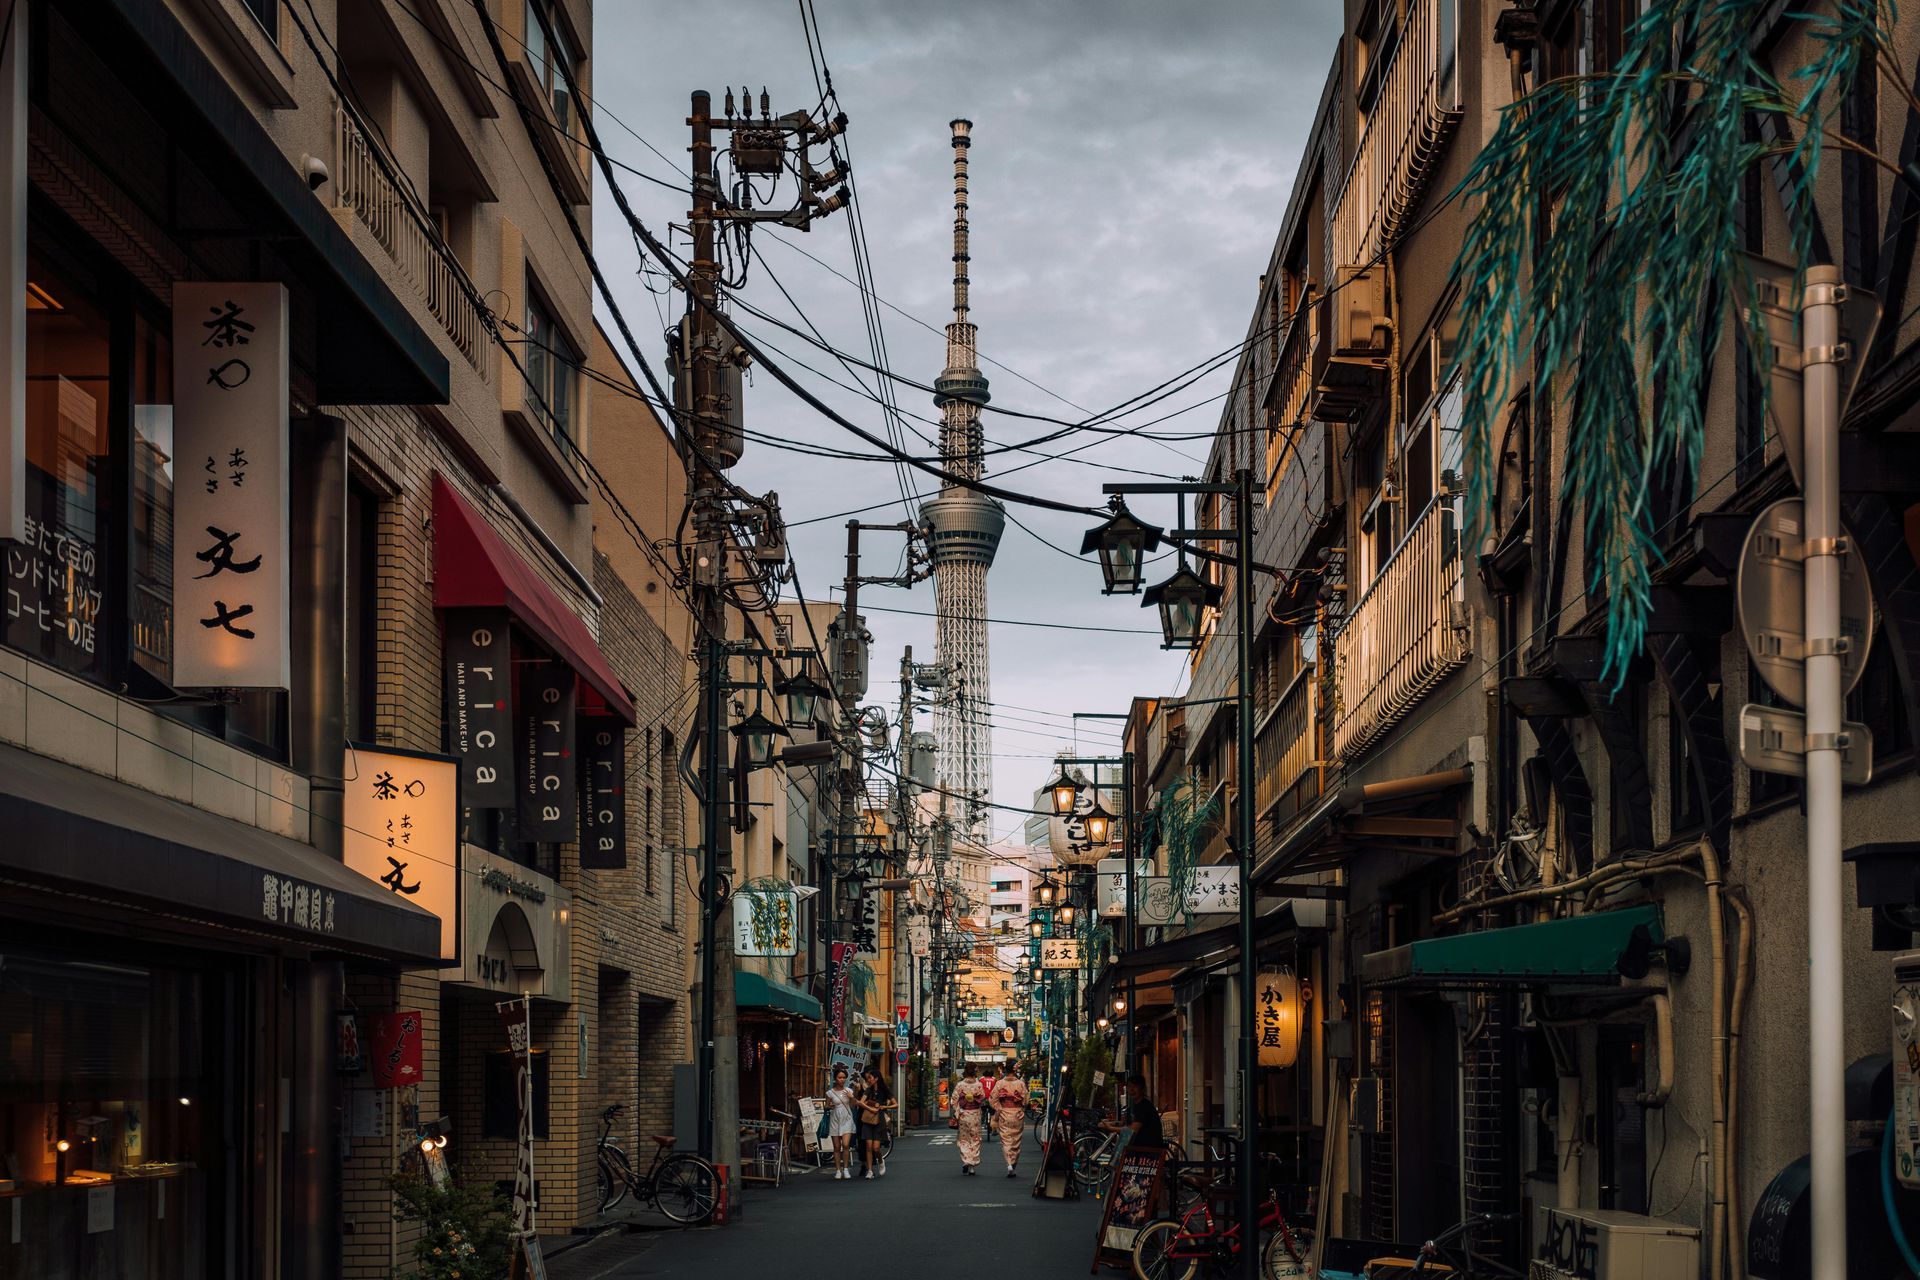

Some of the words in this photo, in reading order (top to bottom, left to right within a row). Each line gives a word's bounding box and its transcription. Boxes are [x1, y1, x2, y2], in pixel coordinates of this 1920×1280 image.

[202, 300, 255, 391] 茶や
[191, 526, 262, 640] 文七
[458, 689, 466, 708] AND
[459, 711, 468, 753] MAKE-UP
[471, 628, 504, 784] erica
[372, 771, 426, 801] 茶や
[542, 687, 569, 822] erica
[596, 731, 620, 851] erica
[1044, 948, 1081, 961] 紀文
[1260, 985, 1283, 1049] かき屋
